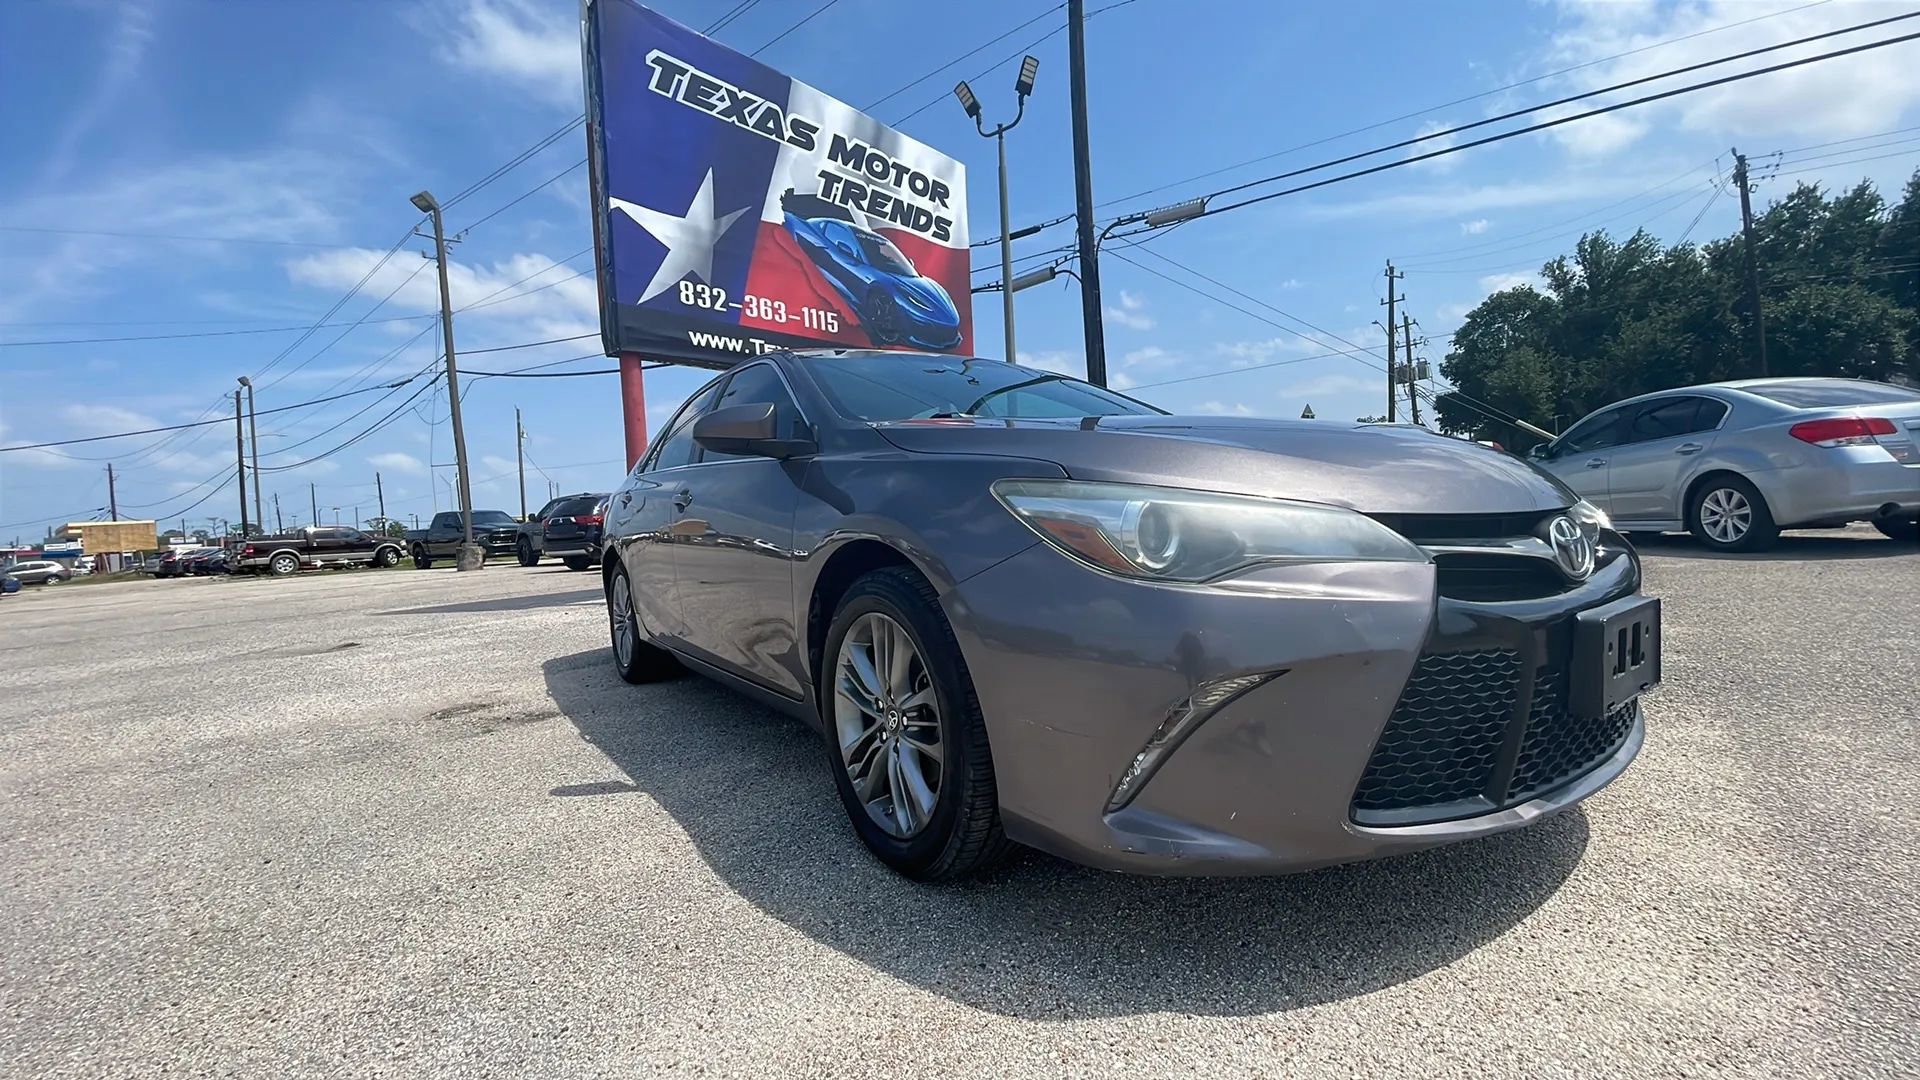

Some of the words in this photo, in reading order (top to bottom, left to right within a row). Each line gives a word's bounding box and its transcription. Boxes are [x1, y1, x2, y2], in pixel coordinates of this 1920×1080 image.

[647, 50, 820, 152] TEXAS
[827, 133, 950, 209] MOTOR
[818, 169, 953, 243] TRENDS
[679, 280, 839, 333] 832-363-1115
